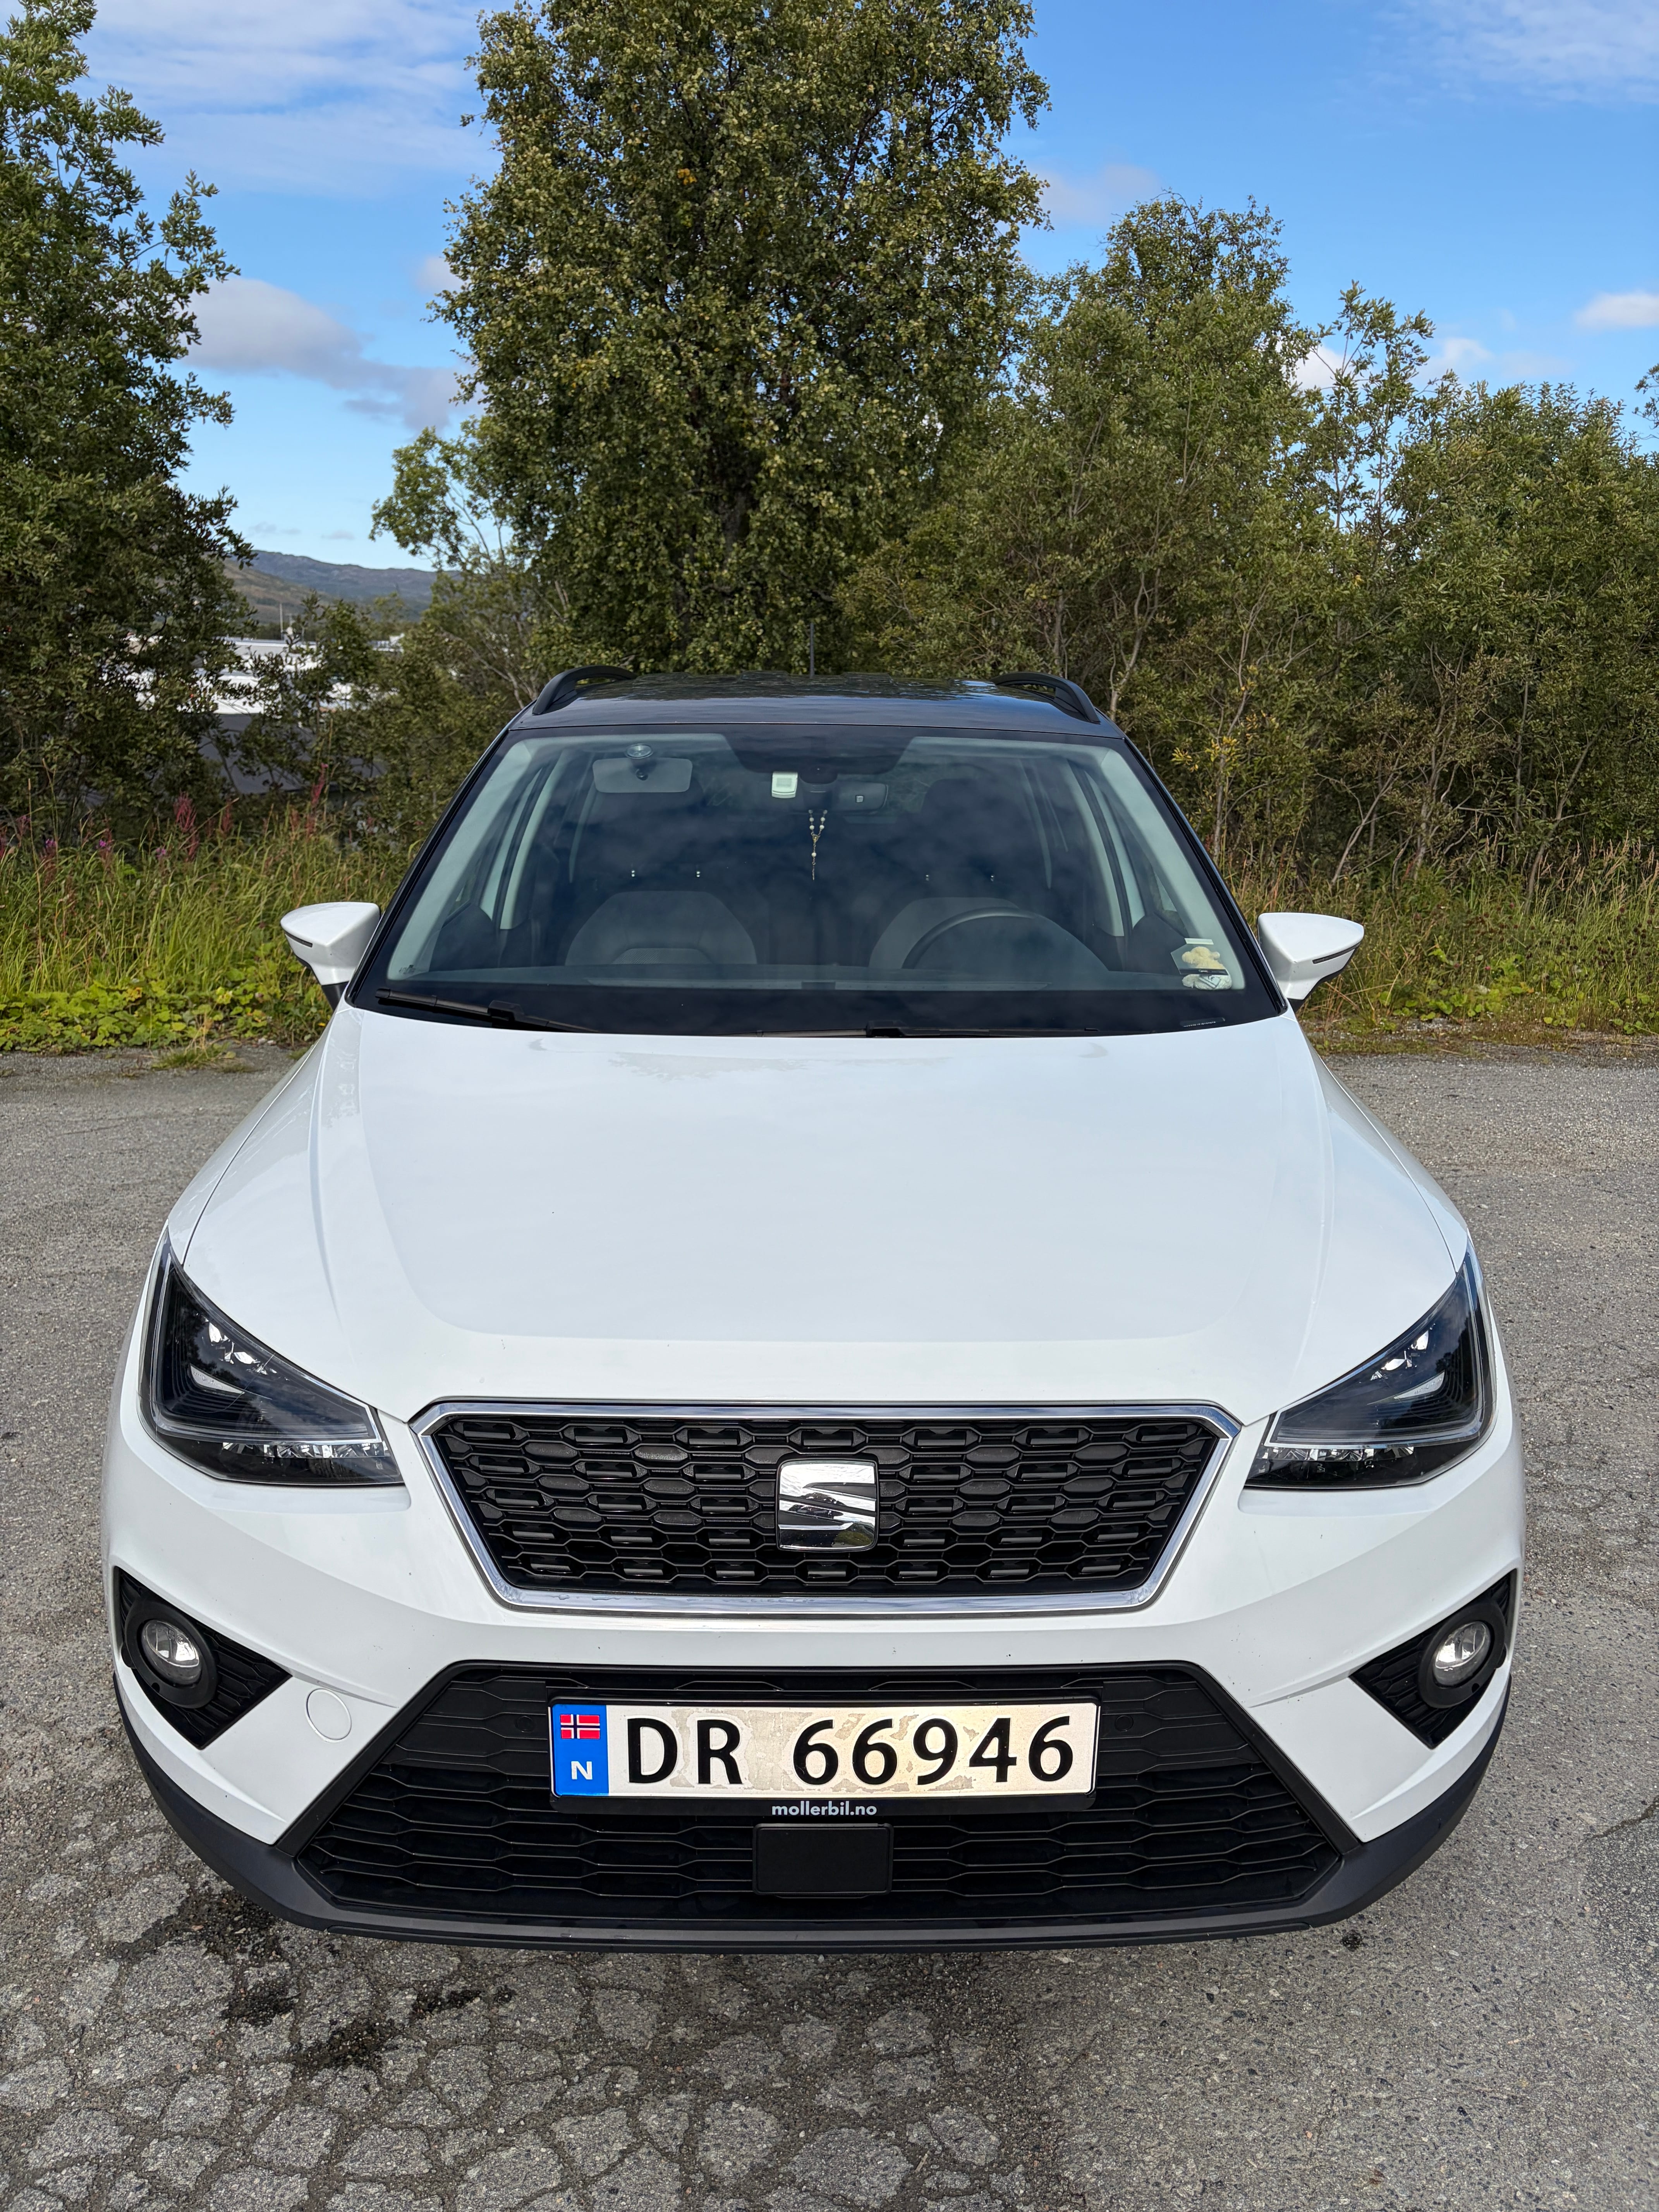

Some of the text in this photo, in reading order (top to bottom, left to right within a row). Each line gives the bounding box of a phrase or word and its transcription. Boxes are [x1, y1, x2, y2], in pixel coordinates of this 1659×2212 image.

[627, 1715, 1073, 1786] DR 66946
[571, 1761, 592, 1780] N
[772, 1800, 877, 1816] mollerbil.no
